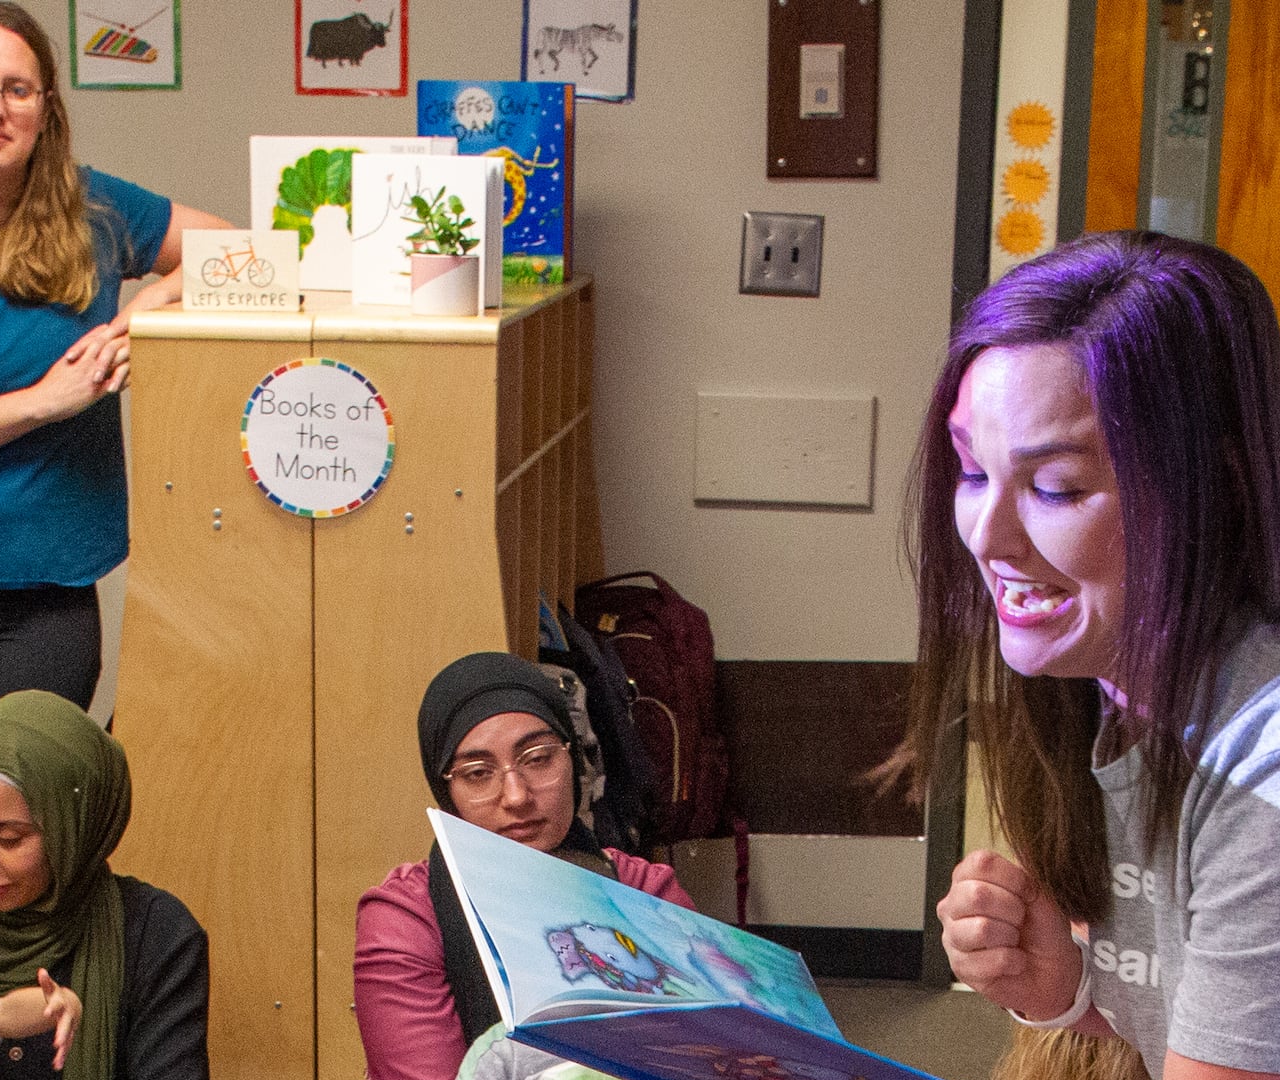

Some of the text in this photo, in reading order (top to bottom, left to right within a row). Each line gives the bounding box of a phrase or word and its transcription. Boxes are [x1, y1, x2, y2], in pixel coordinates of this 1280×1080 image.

[452, 120, 516, 142] DANCE
[228, 292, 287, 307] EXPLORE
[260, 388, 377, 421] Books of
[296, 423, 339, 451] the
[275, 452, 357, 482] Month
